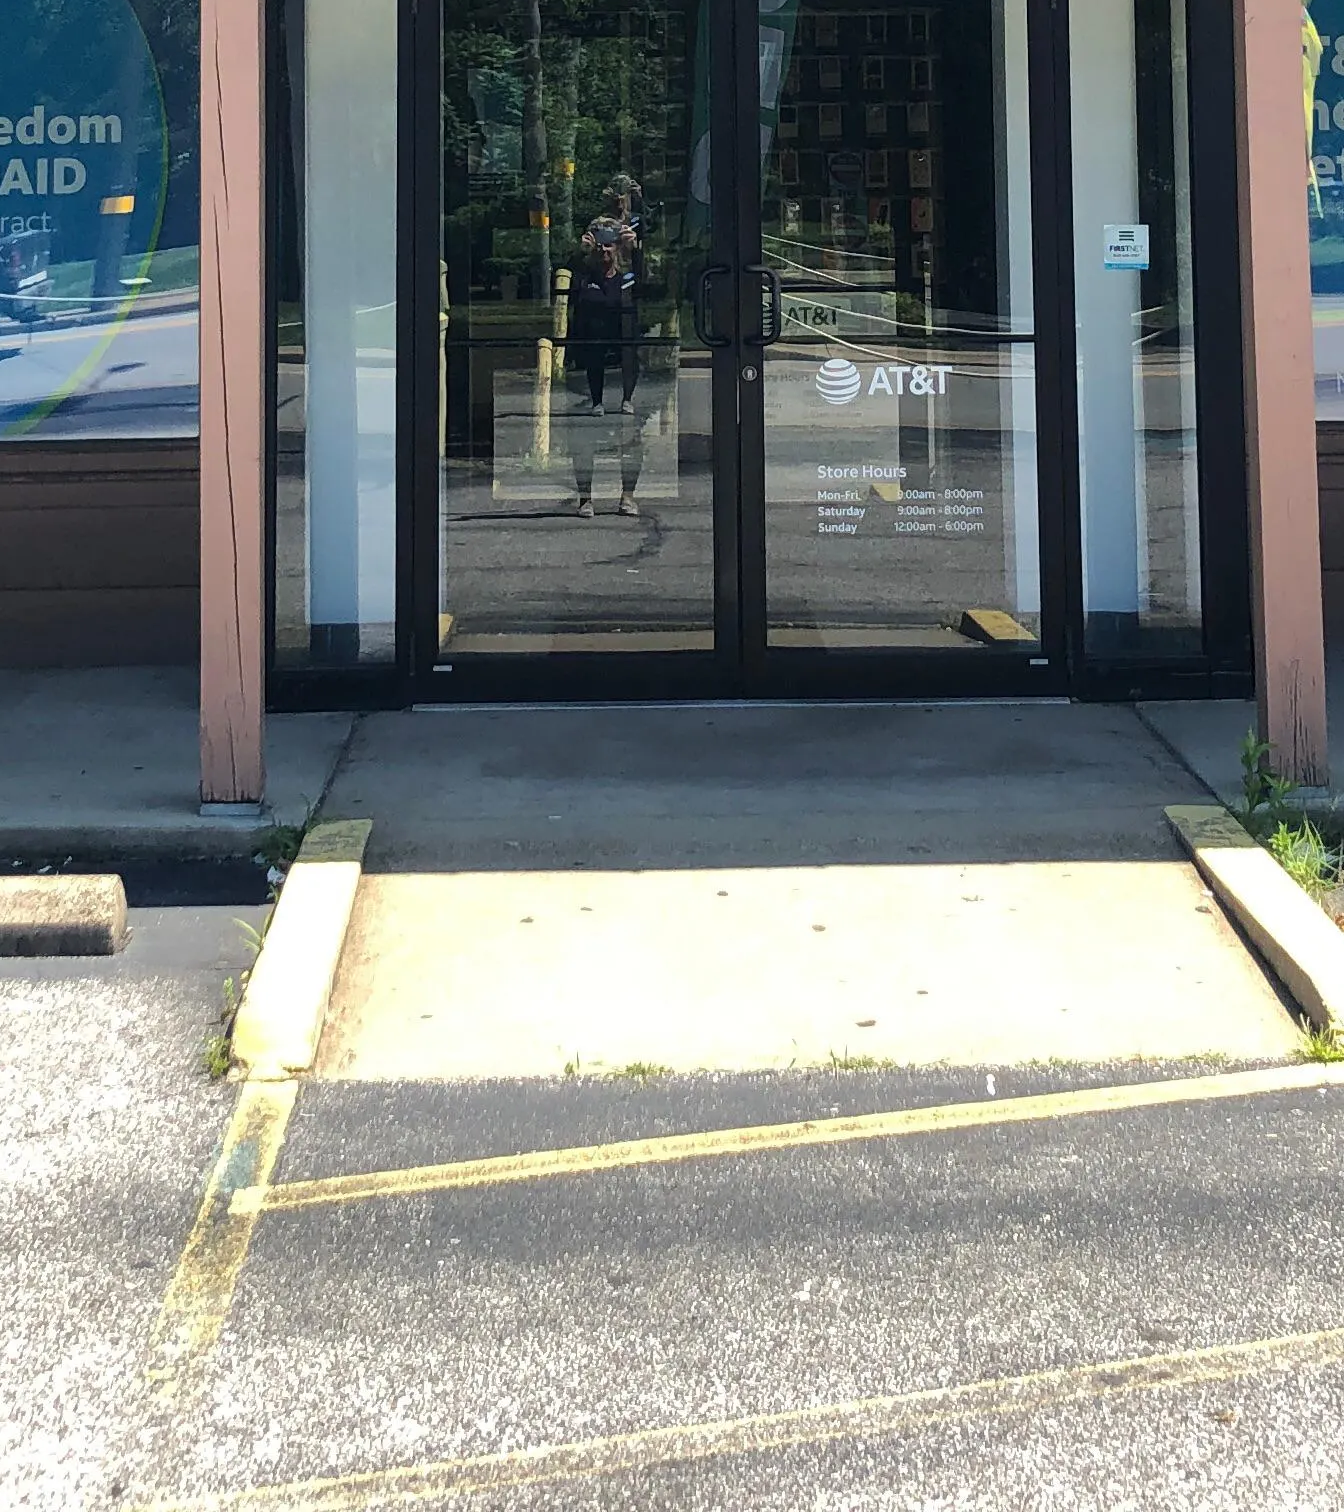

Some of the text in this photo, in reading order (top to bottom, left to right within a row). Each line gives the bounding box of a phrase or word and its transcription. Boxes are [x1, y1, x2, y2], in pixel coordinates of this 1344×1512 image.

[868, 365, 952, 395] AT&T
[817, 465, 907, 479] Store Hours
[817, 506, 866, 518] Saturday
[818, 522, 857, 534] Sunday
